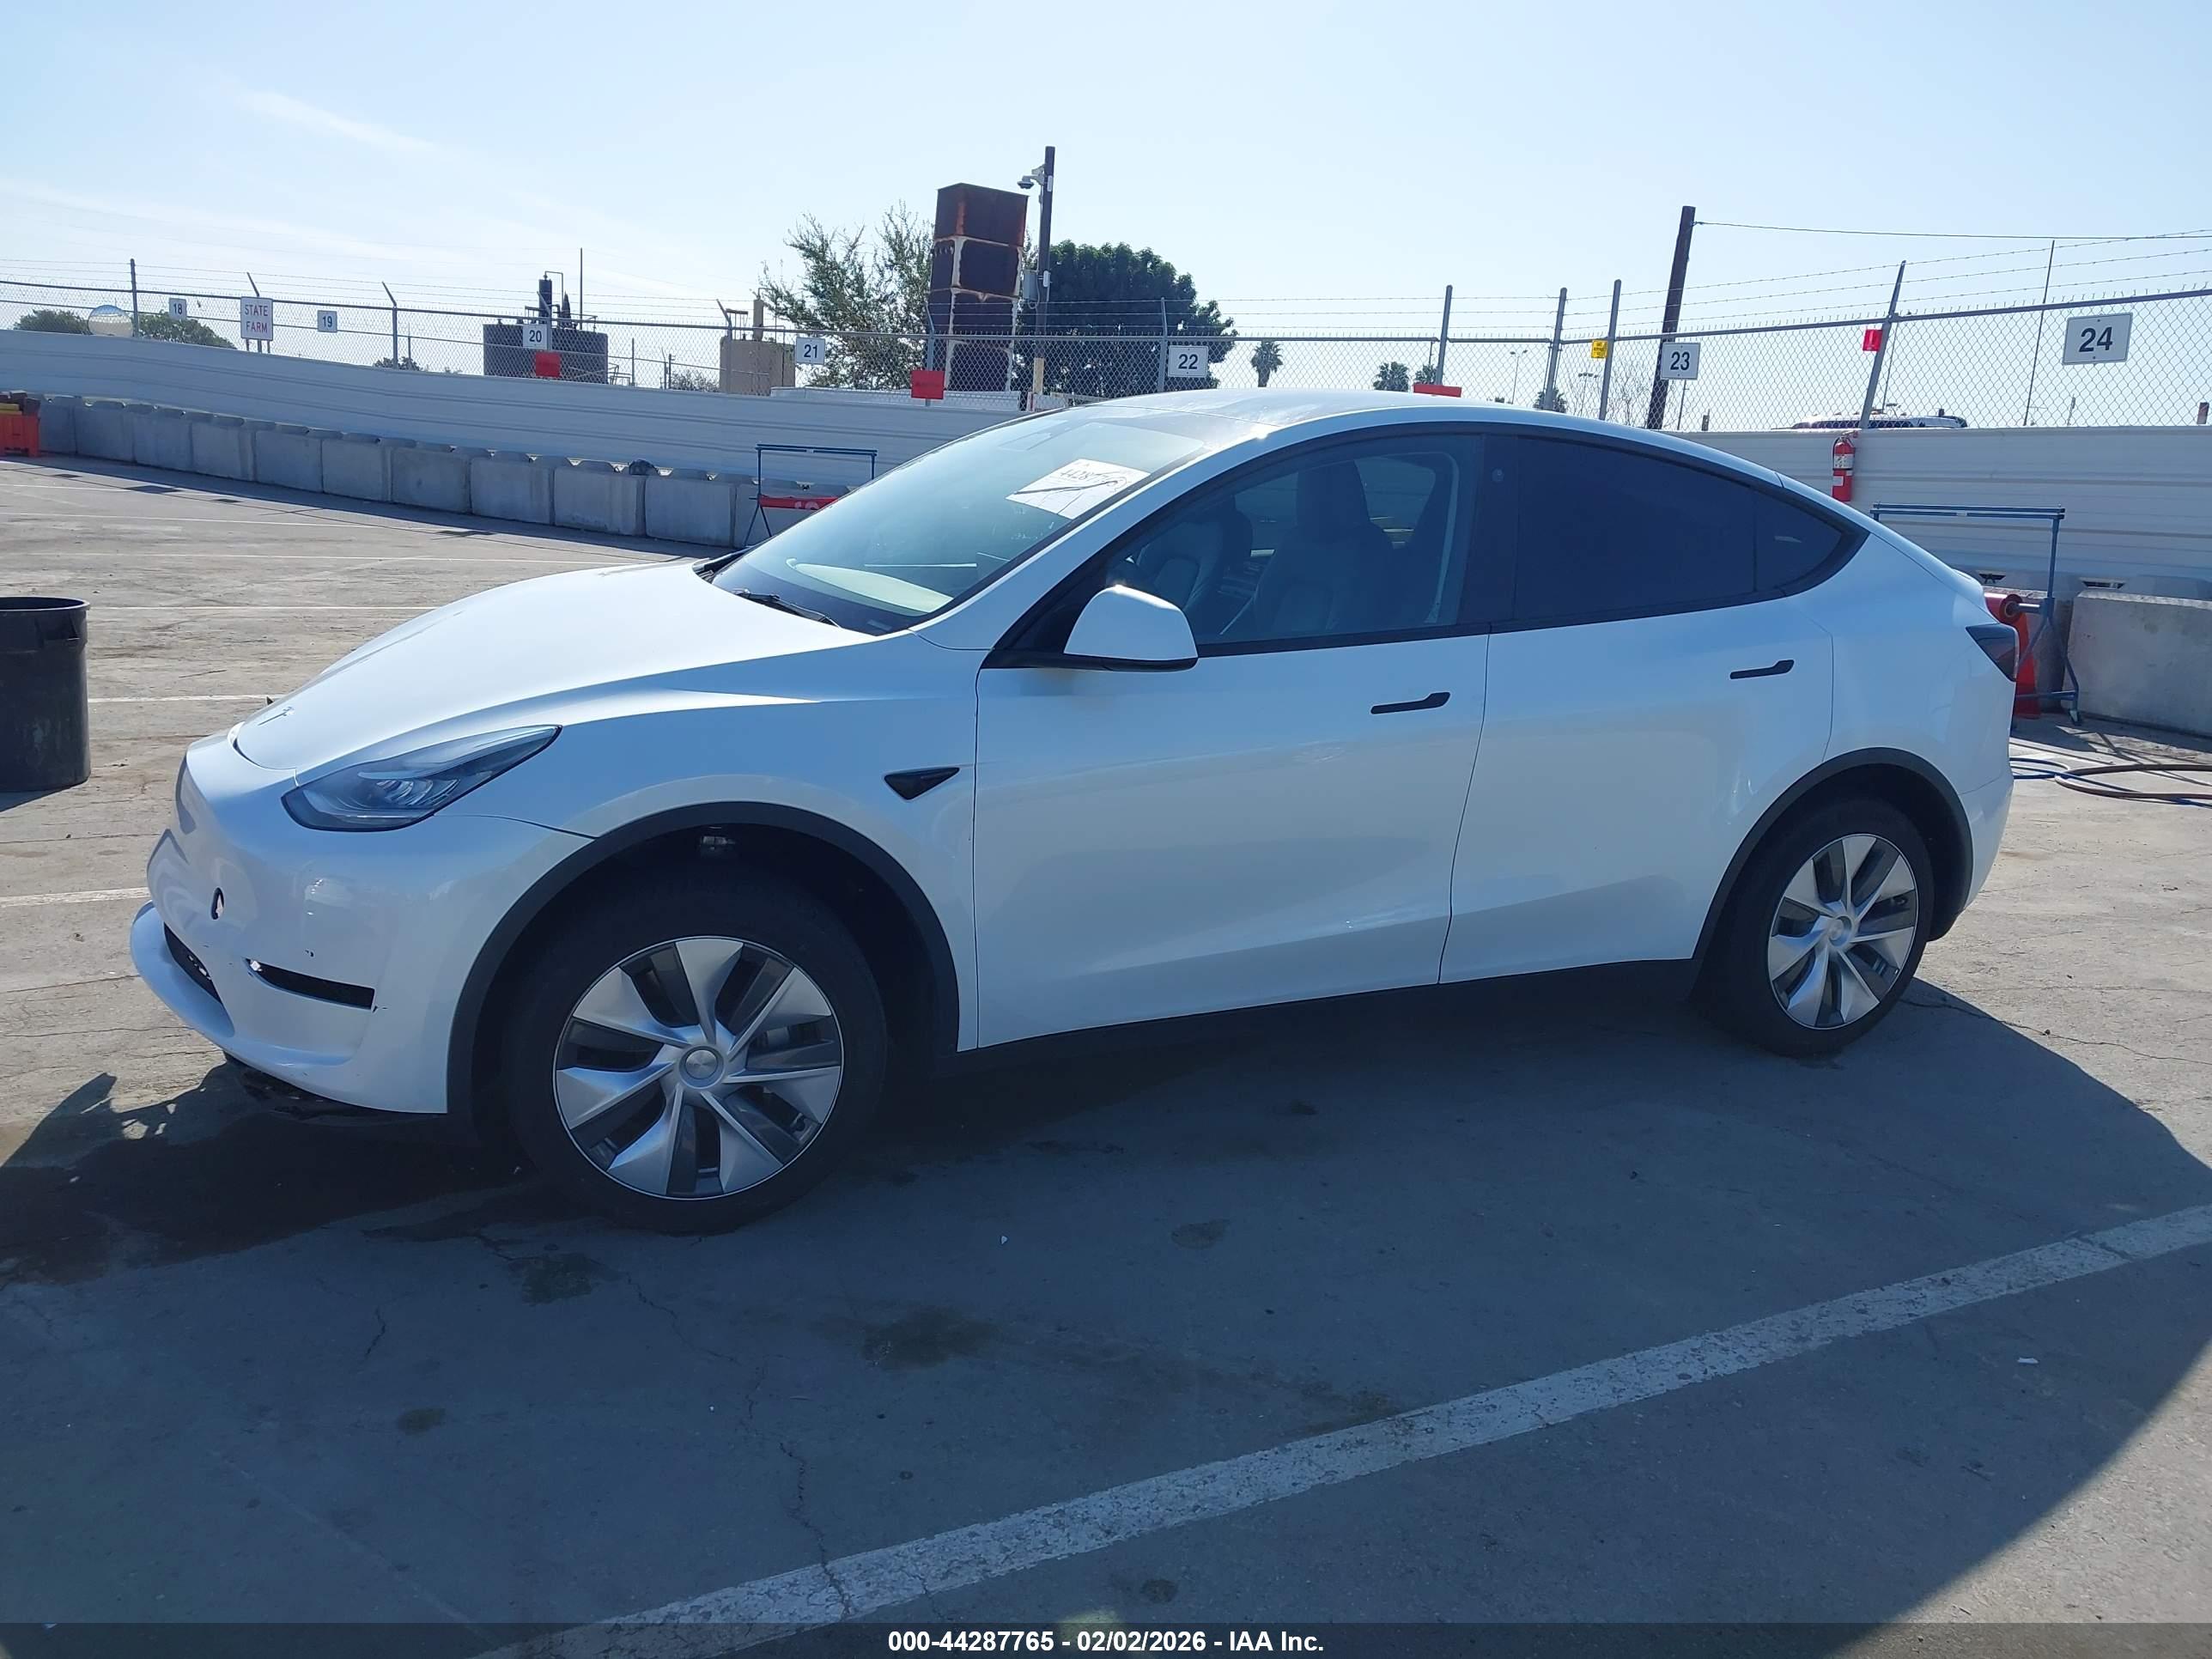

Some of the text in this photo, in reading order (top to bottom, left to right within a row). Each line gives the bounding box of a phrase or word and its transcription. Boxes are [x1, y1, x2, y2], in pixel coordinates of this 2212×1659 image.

[173, 303, 183, 315] 18
[244, 304, 269, 317] STATE
[246, 320, 268, 333] FARM
[322, 315, 333, 328] 19
[529, 329, 543, 343] 20
[2078, 325, 2113, 353] 24
[803, 343, 818, 359] 21
[1177, 353, 1199, 370] 22
[1669, 350, 1690, 371] 23
